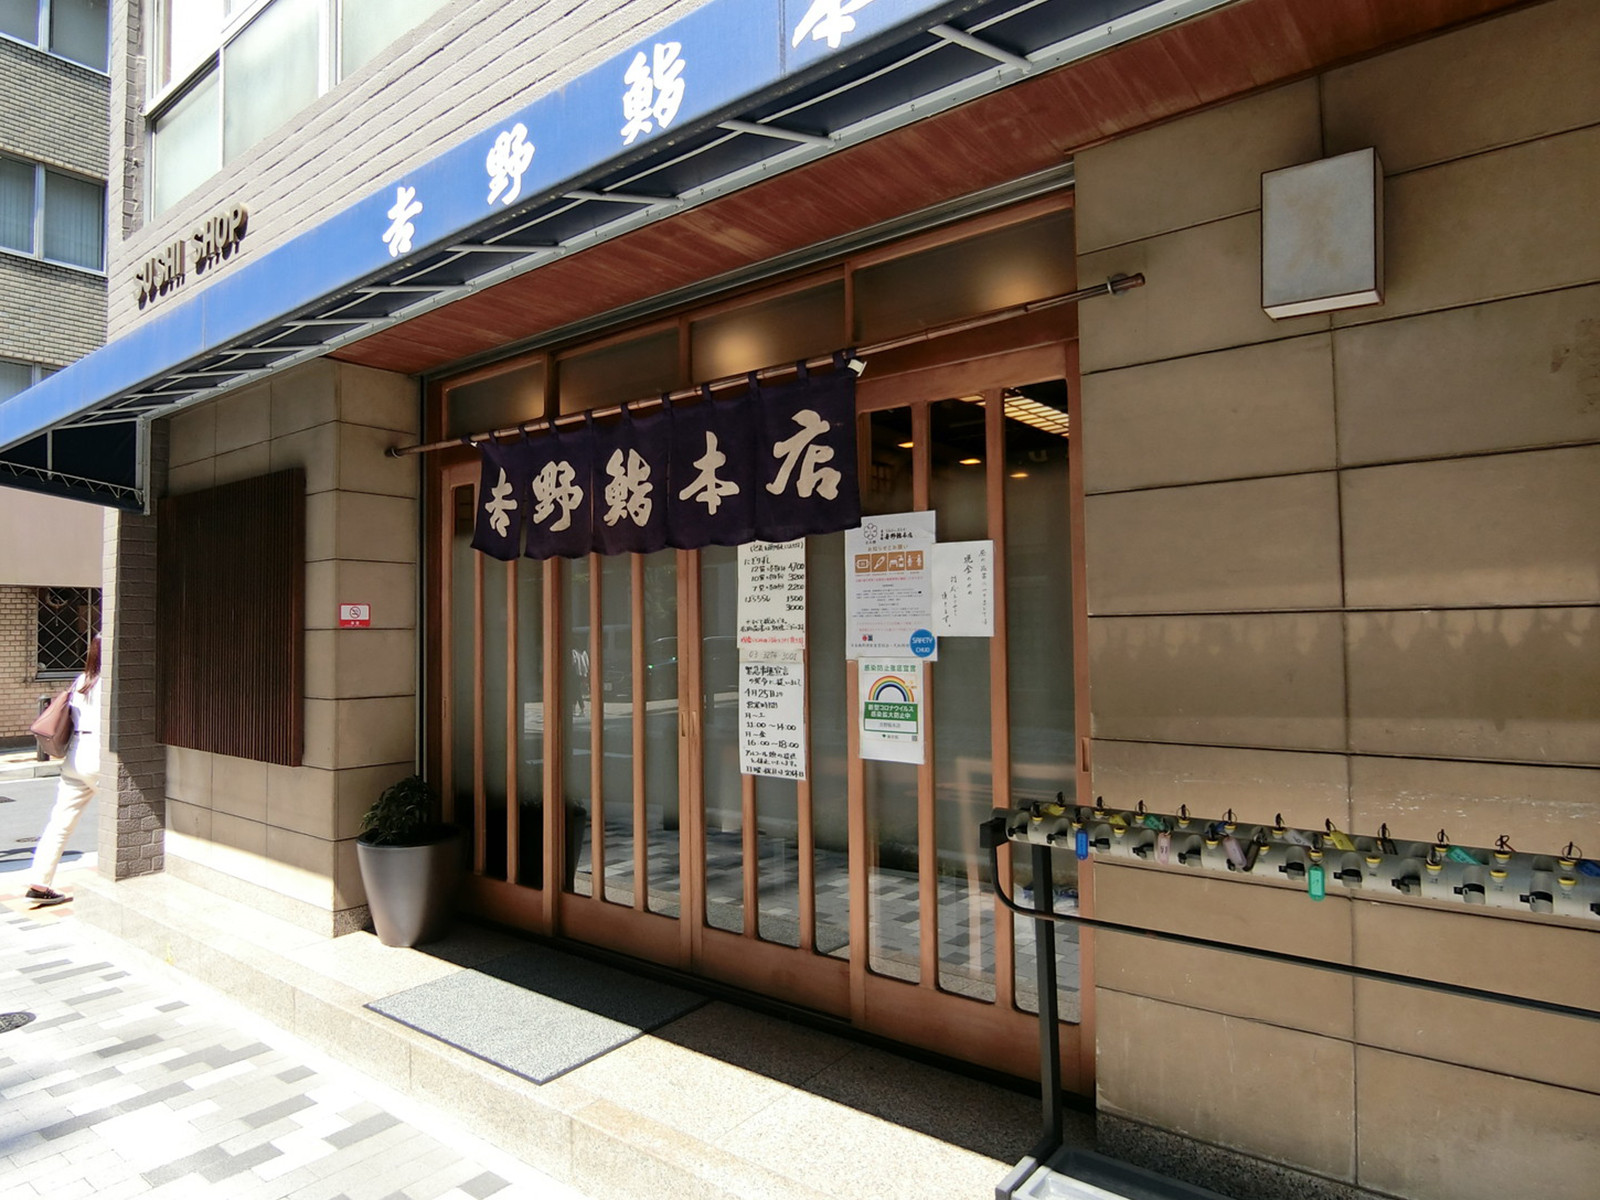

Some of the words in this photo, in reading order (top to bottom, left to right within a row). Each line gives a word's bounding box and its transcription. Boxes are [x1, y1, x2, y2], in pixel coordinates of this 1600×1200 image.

[134, 240, 185, 304] SUSHI
[190, 203, 249, 265] SHOP
[485, 409, 842, 538] 吉野鮨本店
[911, 636, 933, 644] SAFETY
[867, 703, 915, 713] 新型コロナウイルス
[870, 710, 912, 719] 感染拡大防止中
